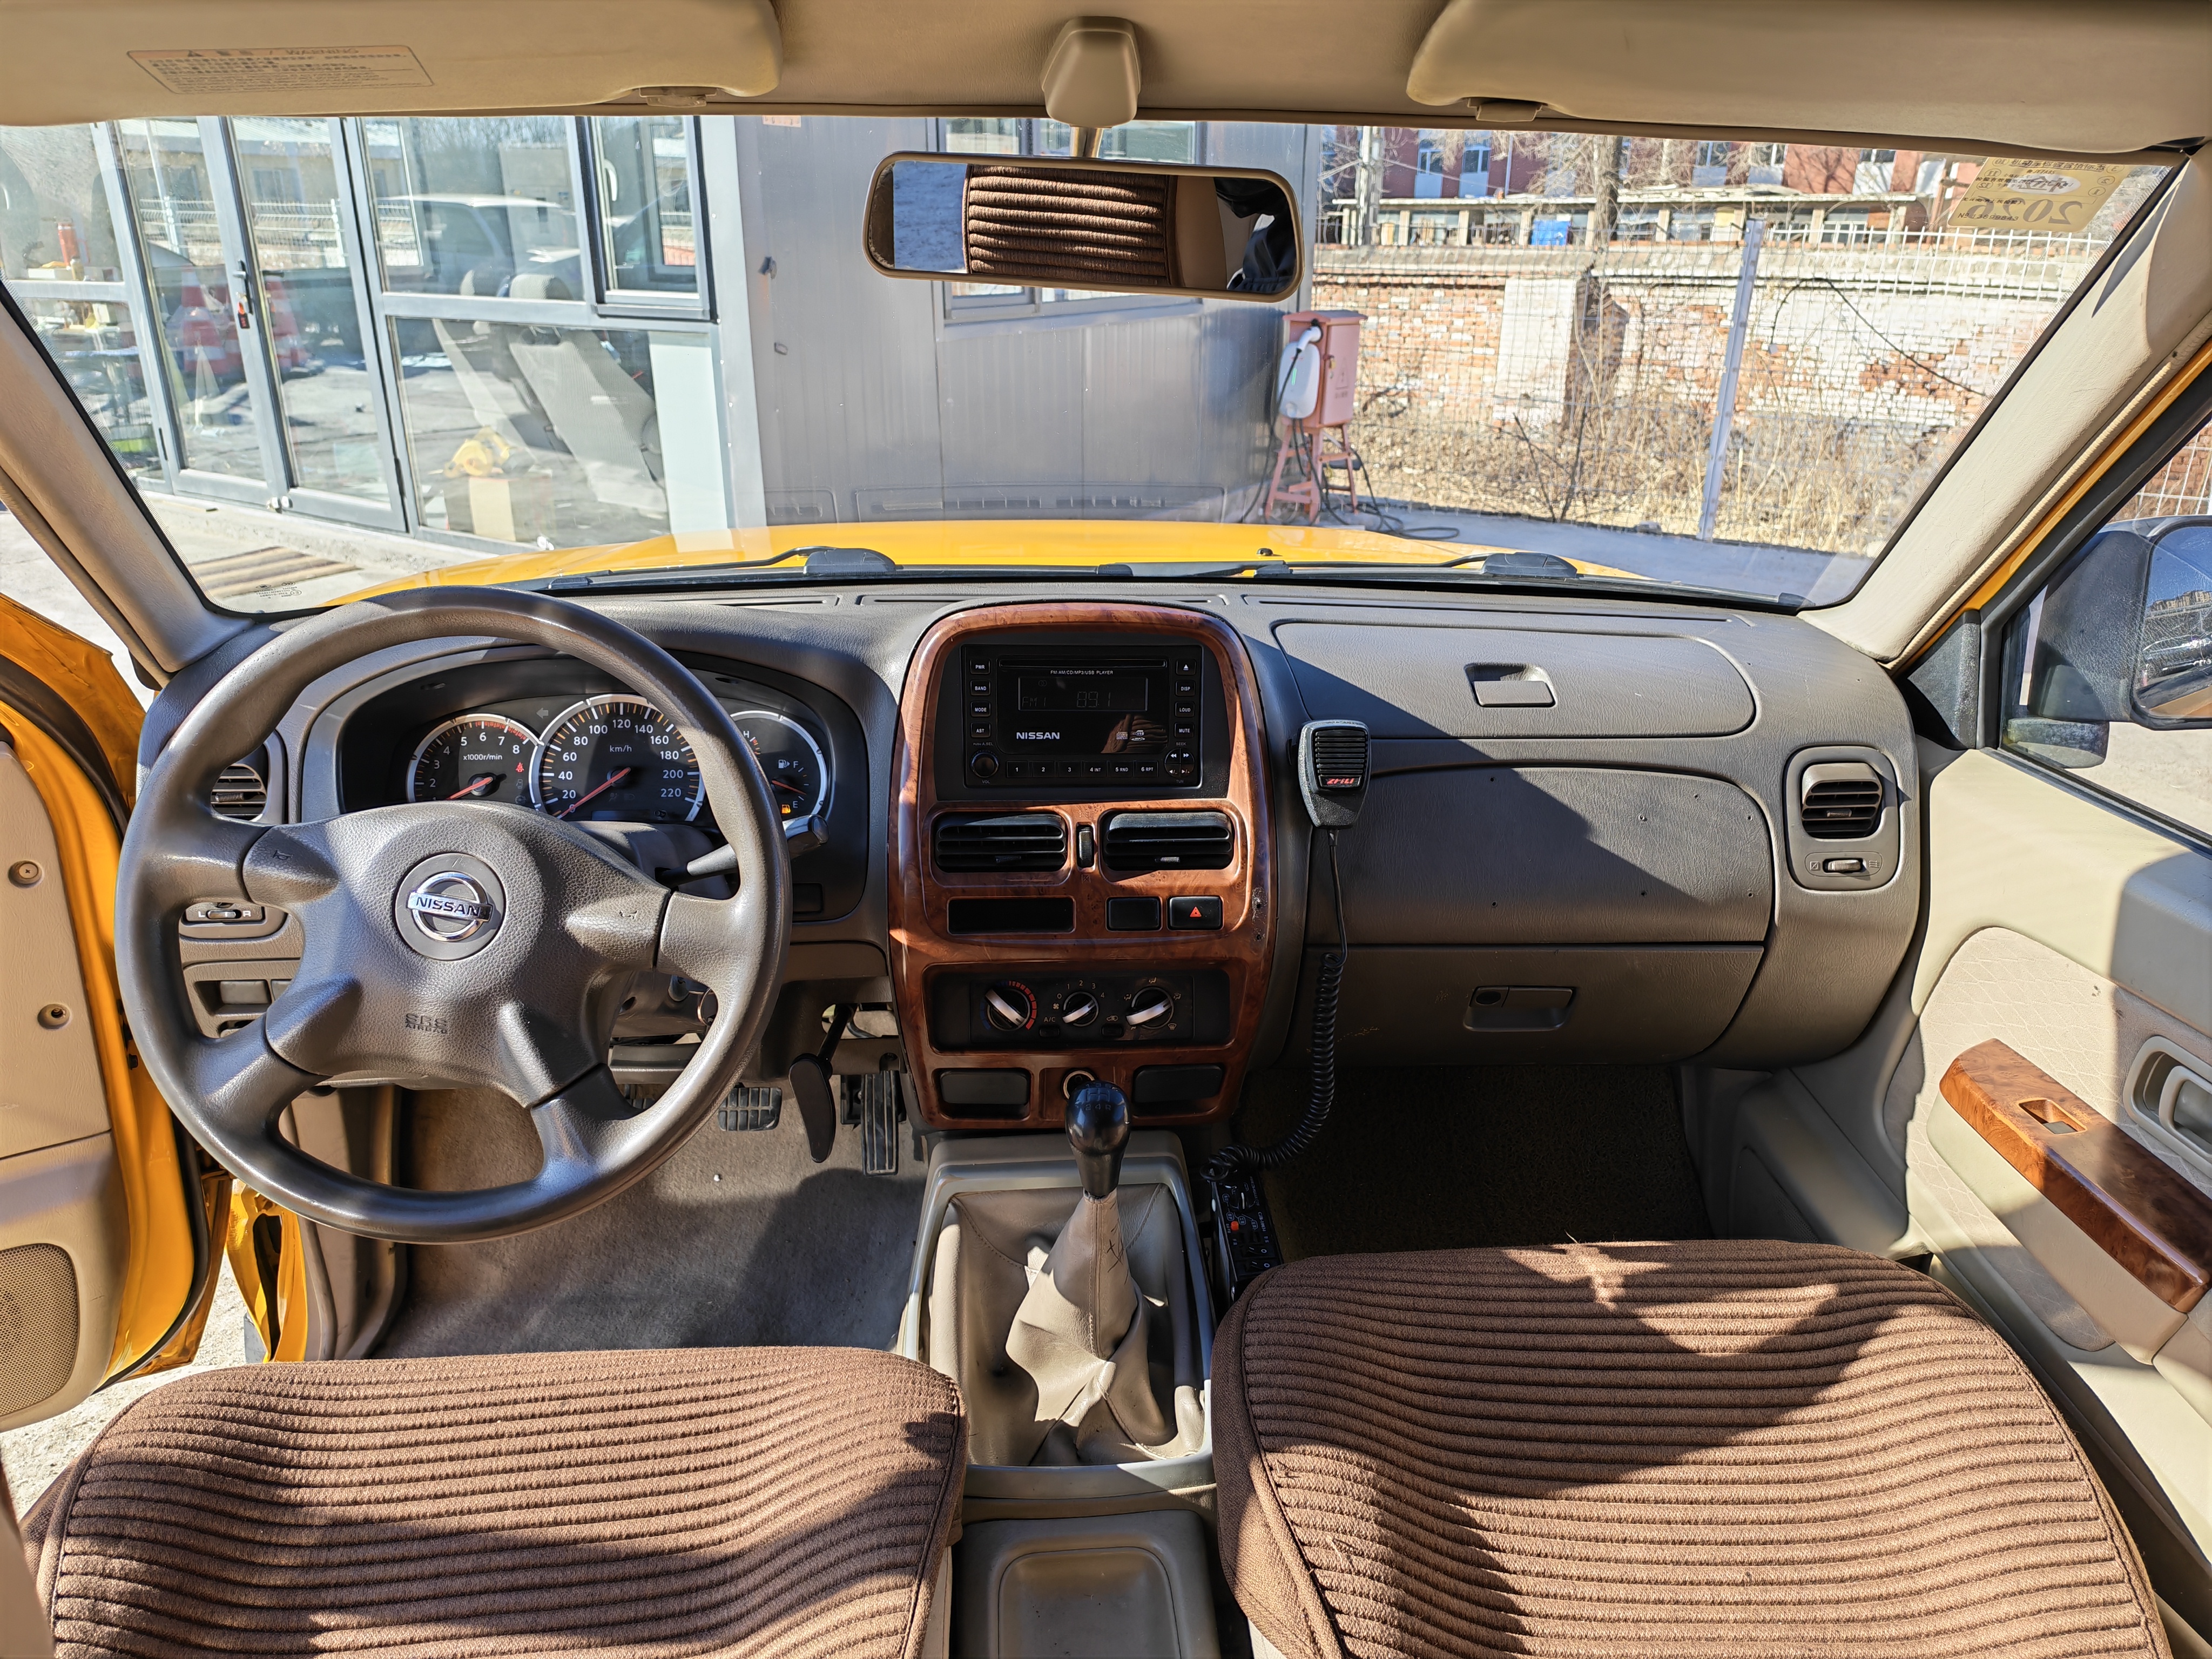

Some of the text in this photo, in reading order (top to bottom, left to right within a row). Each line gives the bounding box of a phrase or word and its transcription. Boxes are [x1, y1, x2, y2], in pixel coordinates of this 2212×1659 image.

[589, 724, 608, 734] 100
[612, 719, 631, 729] 120
[634, 724, 653, 734] 140
[480, 732, 487, 741] 6
[743, 730, 750, 738] H
[1016, 732, 1060, 740] NISSAN
[461, 737, 468, 746] 5
[498, 736, 505, 746] 7
[574, 736, 589, 746] 80
[650, 735, 670, 745] 160
[443, 746, 450, 755] 4
[512, 745, 520, 754] 8
[609, 744, 632, 753] km/h
[562, 751, 577, 762] 60
[660, 750, 680, 760] 180
[434, 760, 440, 769] 3
[793, 760, 799, 768] F
[558, 771, 573, 781] 40
[663, 769, 684, 779] 200
[429, 778, 436, 787] 2
[562, 789, 577, 799] 20
[660, 788, 682, 798] 220
[793, 800, 798, 808] E
[415, 896, 482, 917] NISSAN
[405, 1014, 449, 1028] SRS
[404, 1022, 449, 1034] AIRBAG
